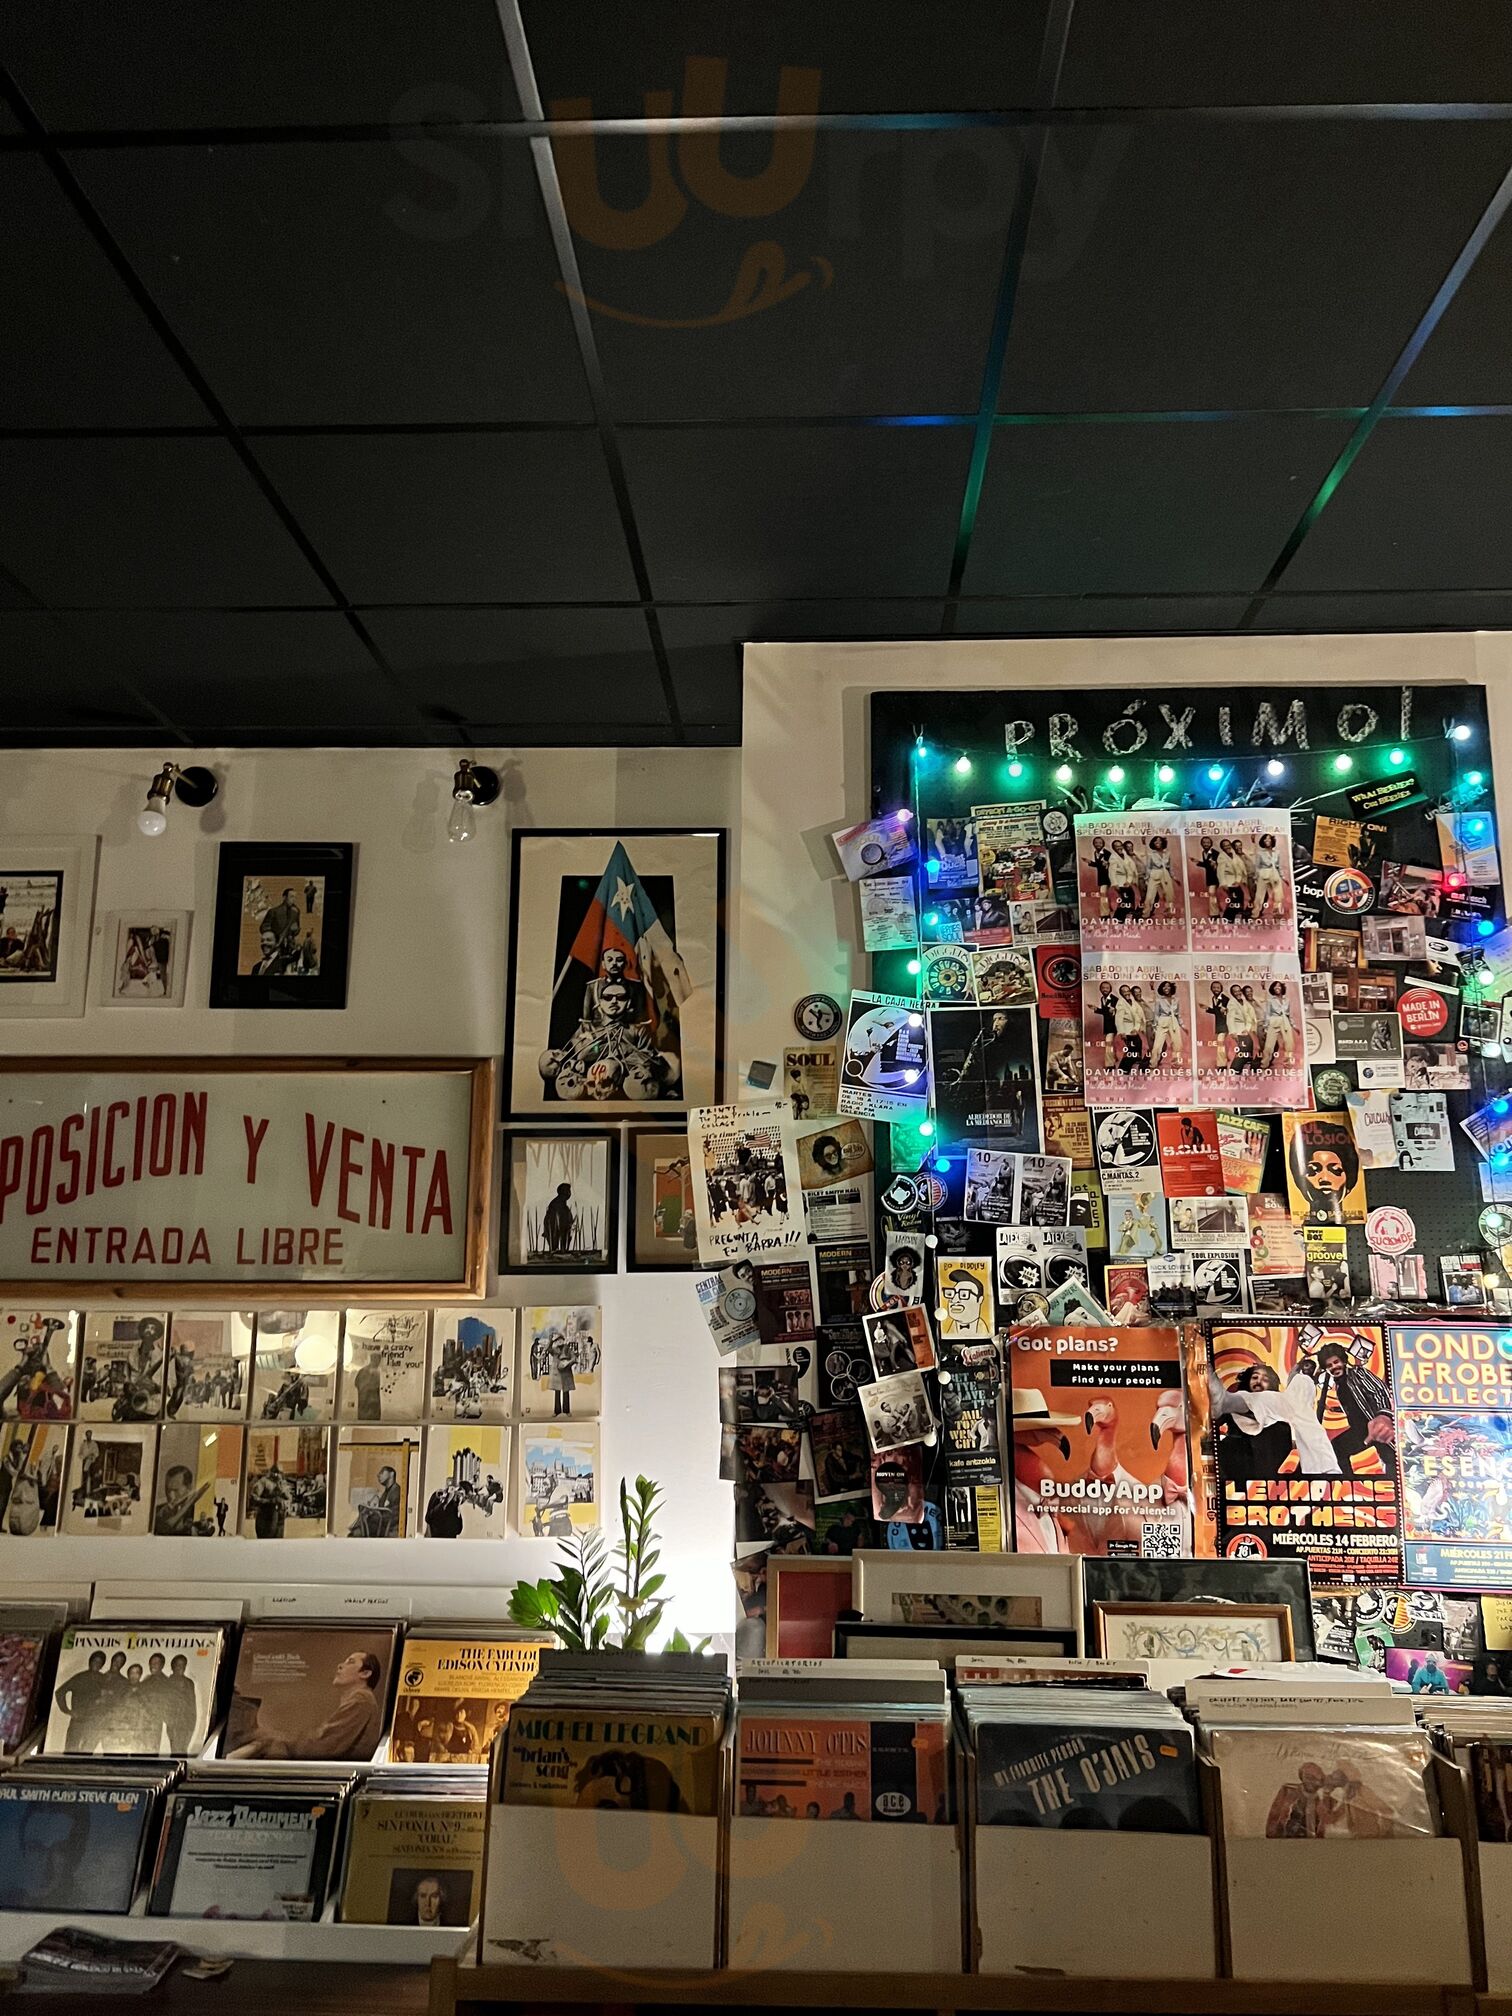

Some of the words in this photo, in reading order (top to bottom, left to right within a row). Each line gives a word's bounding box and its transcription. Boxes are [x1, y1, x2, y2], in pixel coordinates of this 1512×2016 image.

[1329, 818, 1361, 828] RIGHT
[1366, 822, 1387, 832] ON!
[872, 994, 882, 1003] LA
[886, 995, 905, 1006] CAJA
[1402, 1001, 1427, 1012] MADE
[1429, 1000, 1440, 1009] IN
[1406, 1009, 1440, 1023] BERLIN
[786, 1053, 834, 1066] SOUL
[841, 1099, 863, 1107] RADIO
[840, 1109, 875, 1118] VALENCIA
[1217, 1114, 1242, 1126] JAZZ
[976, 1152, 990, 1163] 10
[1030, 1158, 1044, 1168] 10
[0, 1092, 208, 1225] POSICION
[243, 1114, 270, 1185] Y
[305, 1112, 454, 1236] VENTA
[709, 1231, 758, 1246] PREGUNTA
[999, 1232, 1020, 1245] LATEX
[1043, 1232, 1066, 1245] LATEX
[31, 1227, 212, 1265] ENTRADA
[237, 1227, 345, 1266] LIBRE
[724, 1246, 739, 1256] EN
[819, 1250, 852, 1258] MODERN
[960, 1262, 985, 1270] DIDDLEY
[761, 1268, 791, 1277] MODERN
[362, 1342, 381, 1352] have
[391, 1345, 413, 1353] crazy
[1018, 1336, 1052, 1351] Got
[1056, 1336, 1119, 1354] plans?
[381, 1351, 405, 1359] friend
[1072, 1363, 1099, 1371] Make
[1103, 1365, 1126, 1373] your
[1130, 1364, 1160, 1373] plans
[1098, 1378, 1121, 1386] your
[1126, 1377, 1162, 1386] people
[1040, 1479, 1163, 1504] BuddyApp
[1225, 1480, 1397, 1501] LEHMANNS
[1027, 1504, 1034, 1512] A
[1060, 1505, 1090, 1514] social
[1092, 1507, 1112, 1516] app
[1114, 1506, 1130, 1515] for
[1132, 1506, 1176, 1516] Valencia
[1226, 1506, 1397, 1527] BROTHERS
[1272, 1530, 1333, 1545] MIÉRCOLES
[1335, 1534, 1349, 1546] 14
[1350, 1534, 1398, 1547] FEBRERO
[1440, 1547, 1489, 1559] MIÉRCOLES
[67, 1635, 121, 1648] SPINNERS
[460, 1648, 485, 1659] THE
[437, 1659, 483, 1670] EDISON
[516, 1719, 599, 1743] MICHEL
[603, 1721, 710, 1746] LEGRAND
[747, 1728, 819, 1753] JOHNNY
[827, 1731, 869, 1756] OTIS
[1010, 1750, 1050, 1781] FAVORITE
[1050, 1737, 1086, 1765] PERSON
[1027, 1767, 1074, 1815] THE
[1079, 1734, 1156, 1793] O'JAYS
[0, 1788, 17, 1800] AUL
[19, 1789, 51, 1800] SMITH
[52, 1790, 77, 1801] PLAYS
[78, 1791, 106, 1802] STEVE
[109, 1792, 140, 1803] ALLEN
